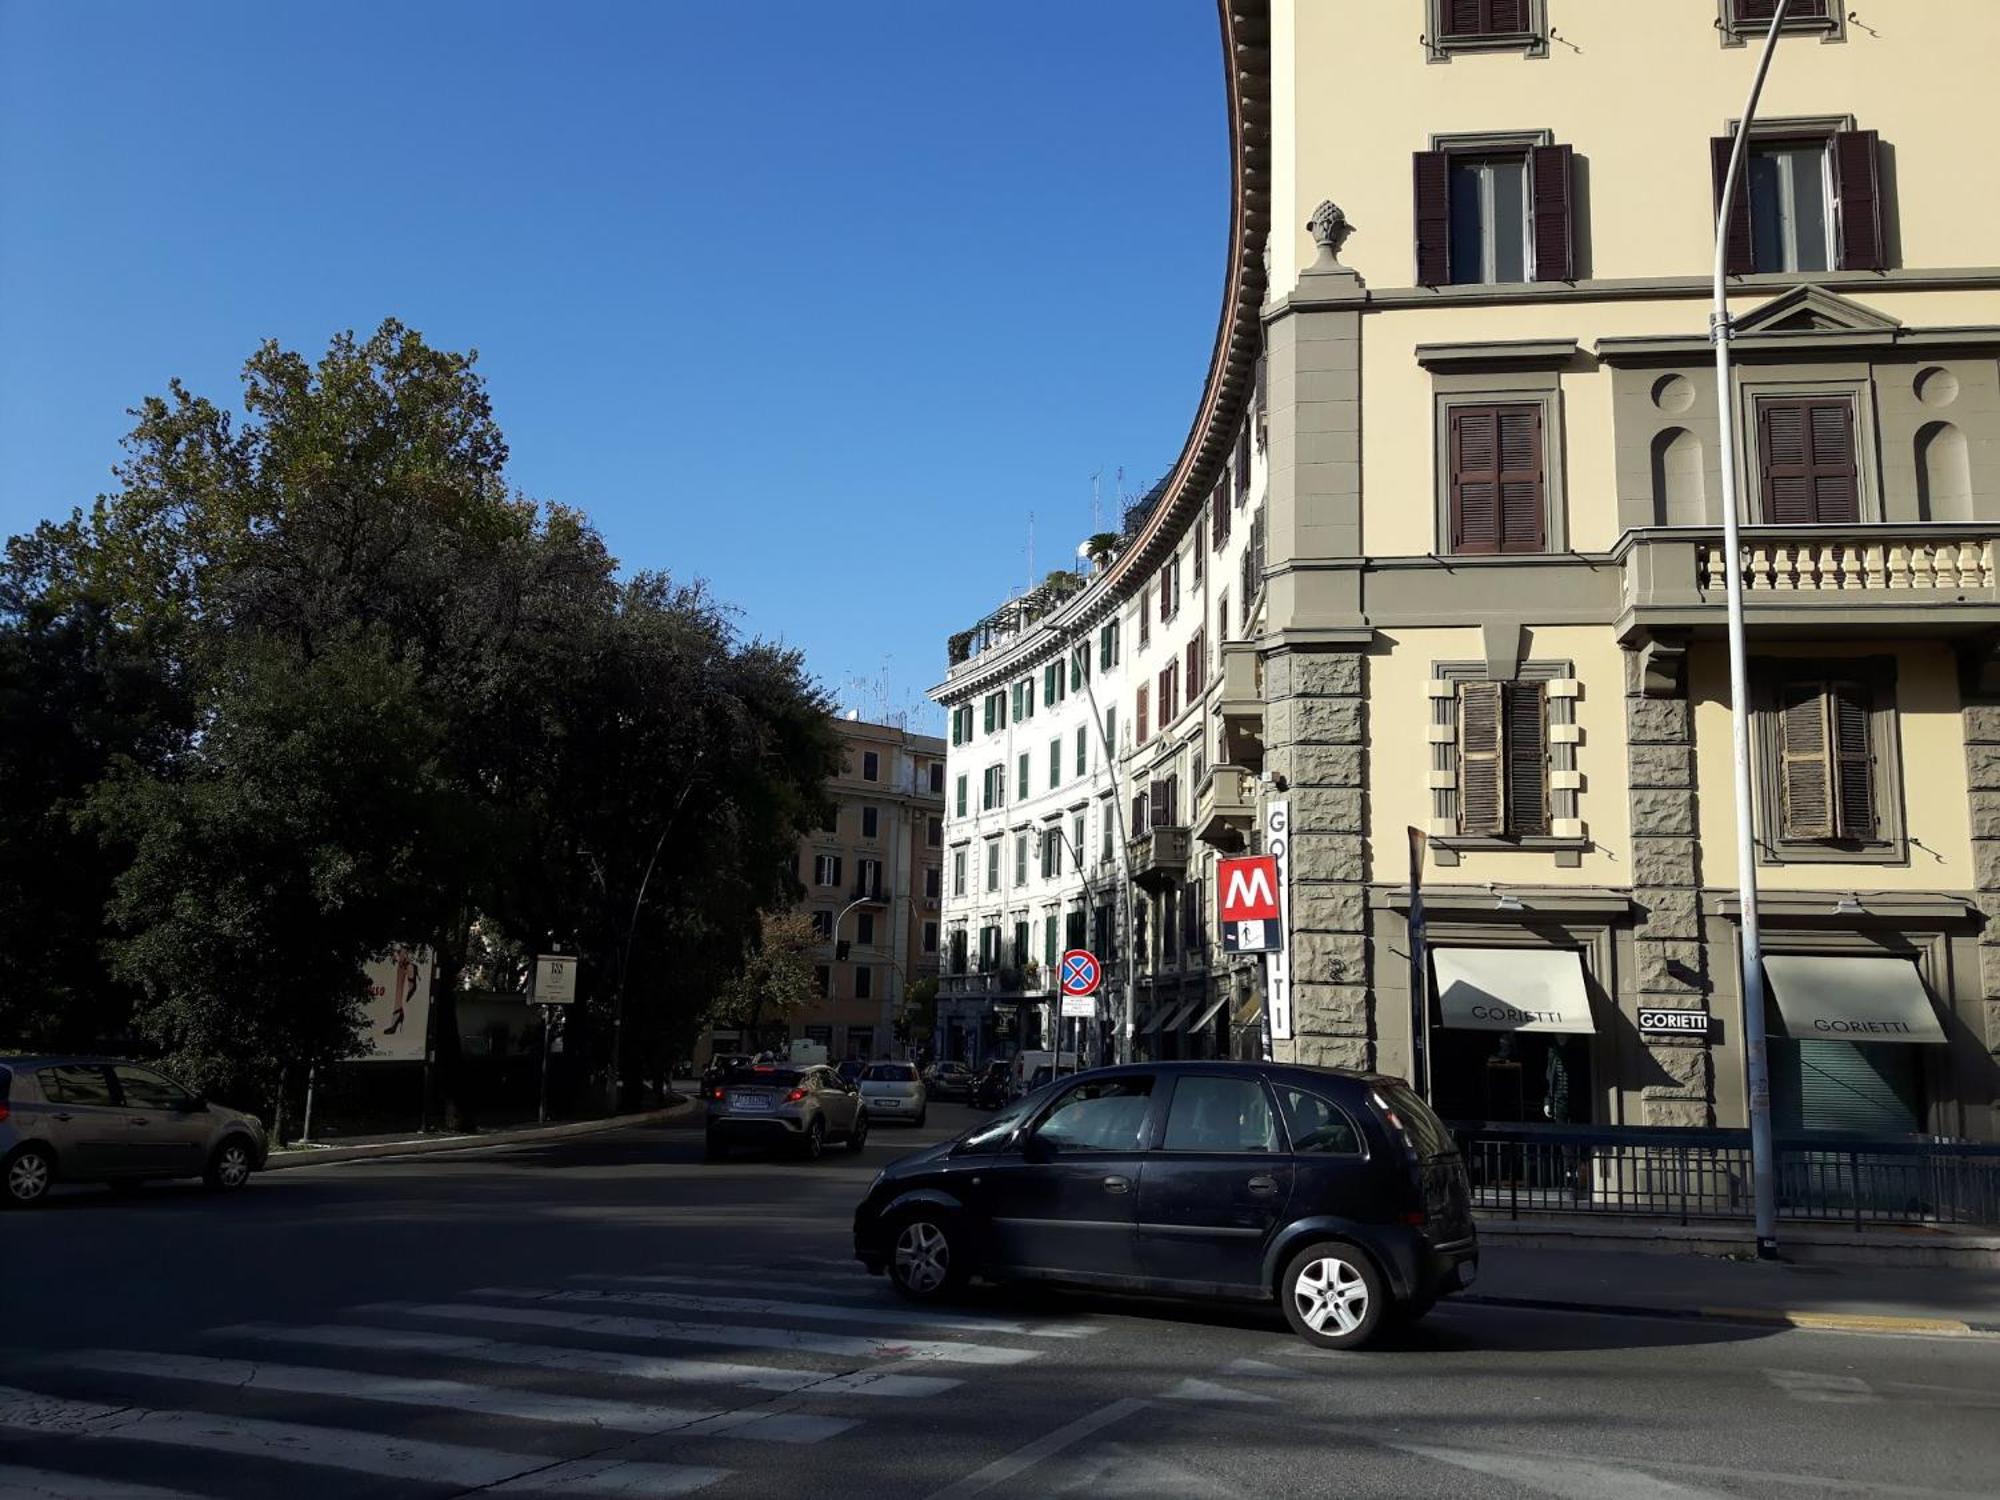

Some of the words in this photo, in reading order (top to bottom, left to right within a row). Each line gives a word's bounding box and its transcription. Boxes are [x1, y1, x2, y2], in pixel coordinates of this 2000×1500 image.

[1224, 867, 1274, 909] M
[1471, 1006, 1562, 1023] GORIETTI
[1639, 1013, 1708, 1029] GORIETTI
[1813, 1019, 1911, 1033] GORIETTI
